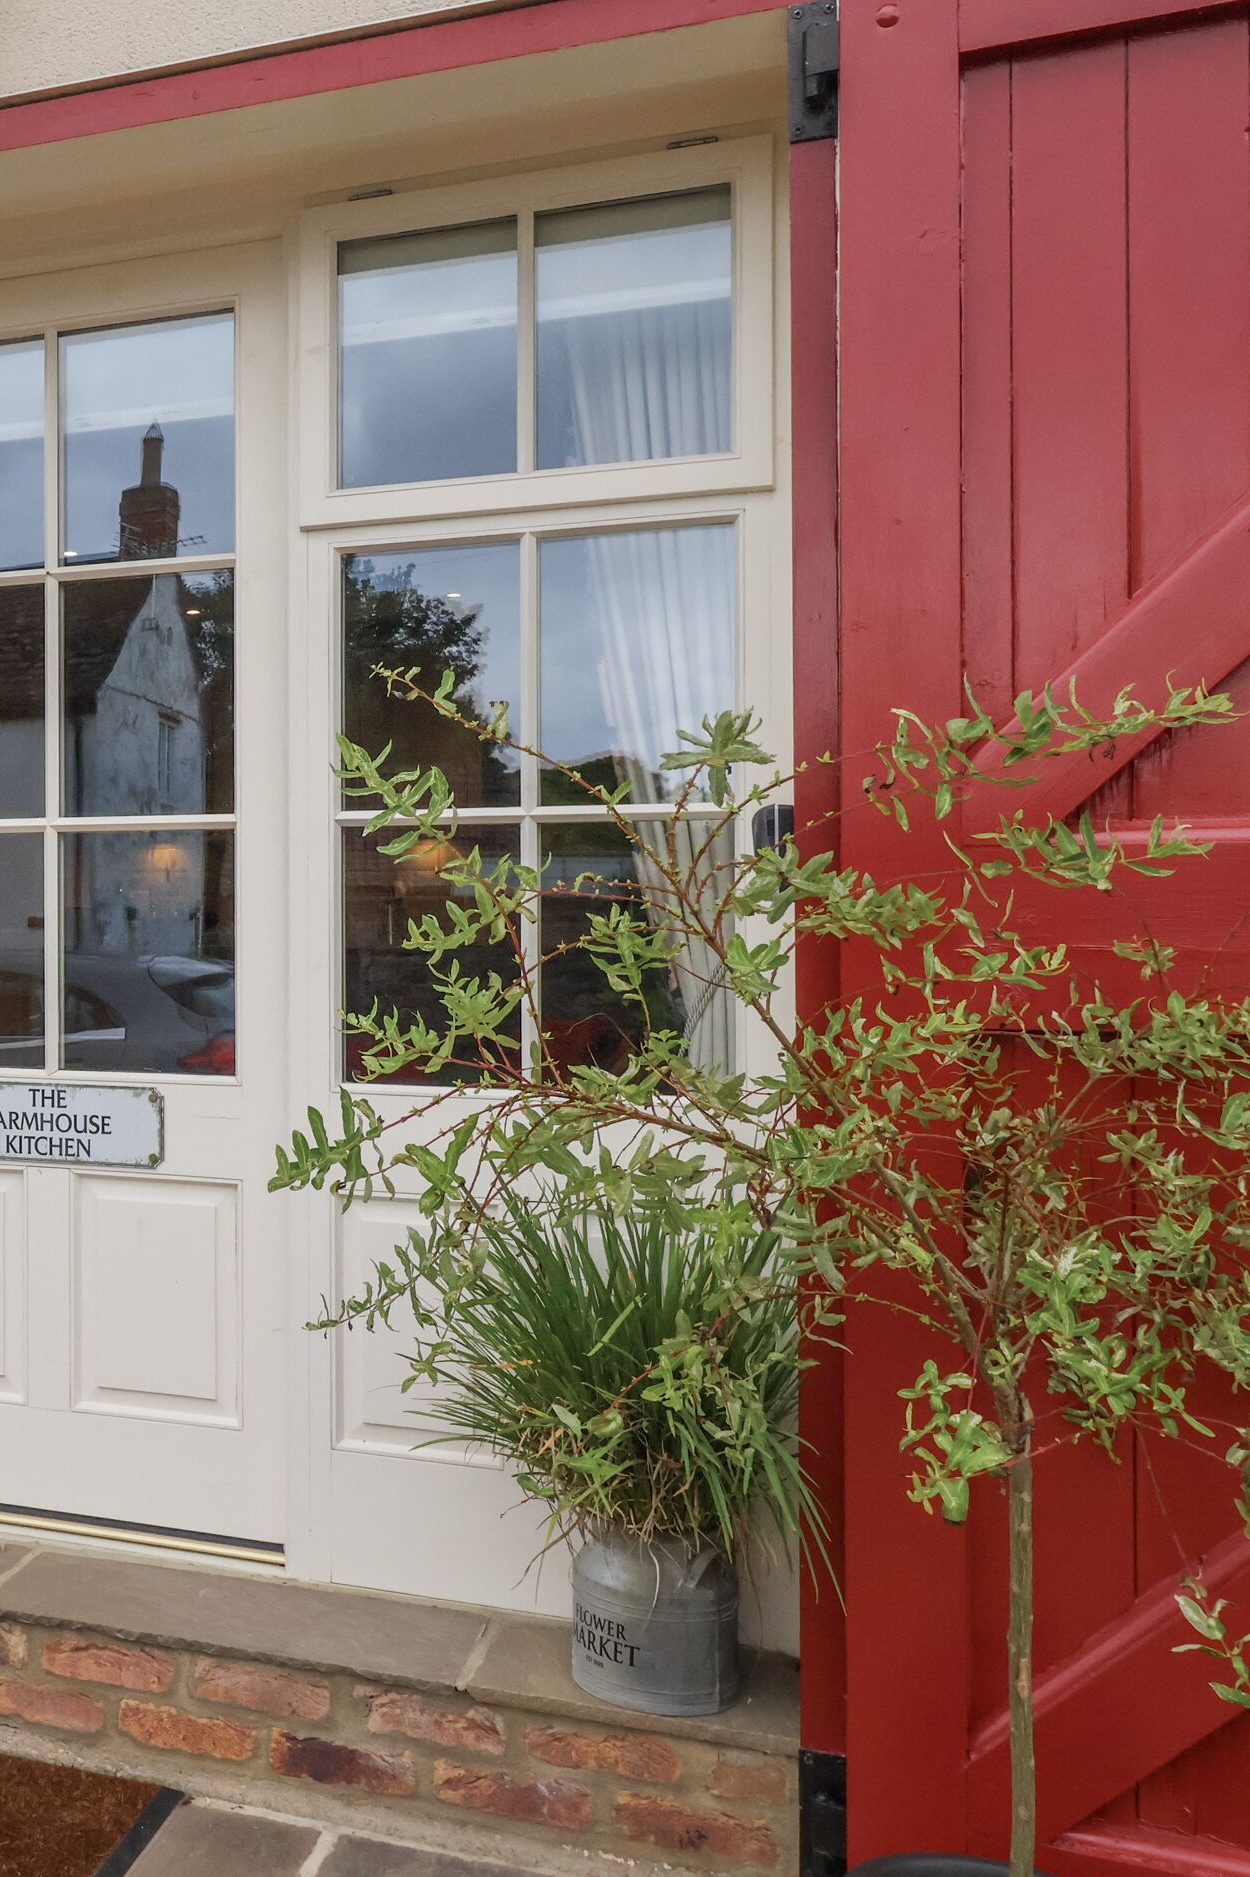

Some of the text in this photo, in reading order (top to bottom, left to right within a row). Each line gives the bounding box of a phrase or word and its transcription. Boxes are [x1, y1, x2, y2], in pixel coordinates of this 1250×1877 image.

[28, 1088, 67, 1109] THE
[5, 1135, 92, 1158] KITCHEN
[575, 1602, 628, 1641] FLOWER
